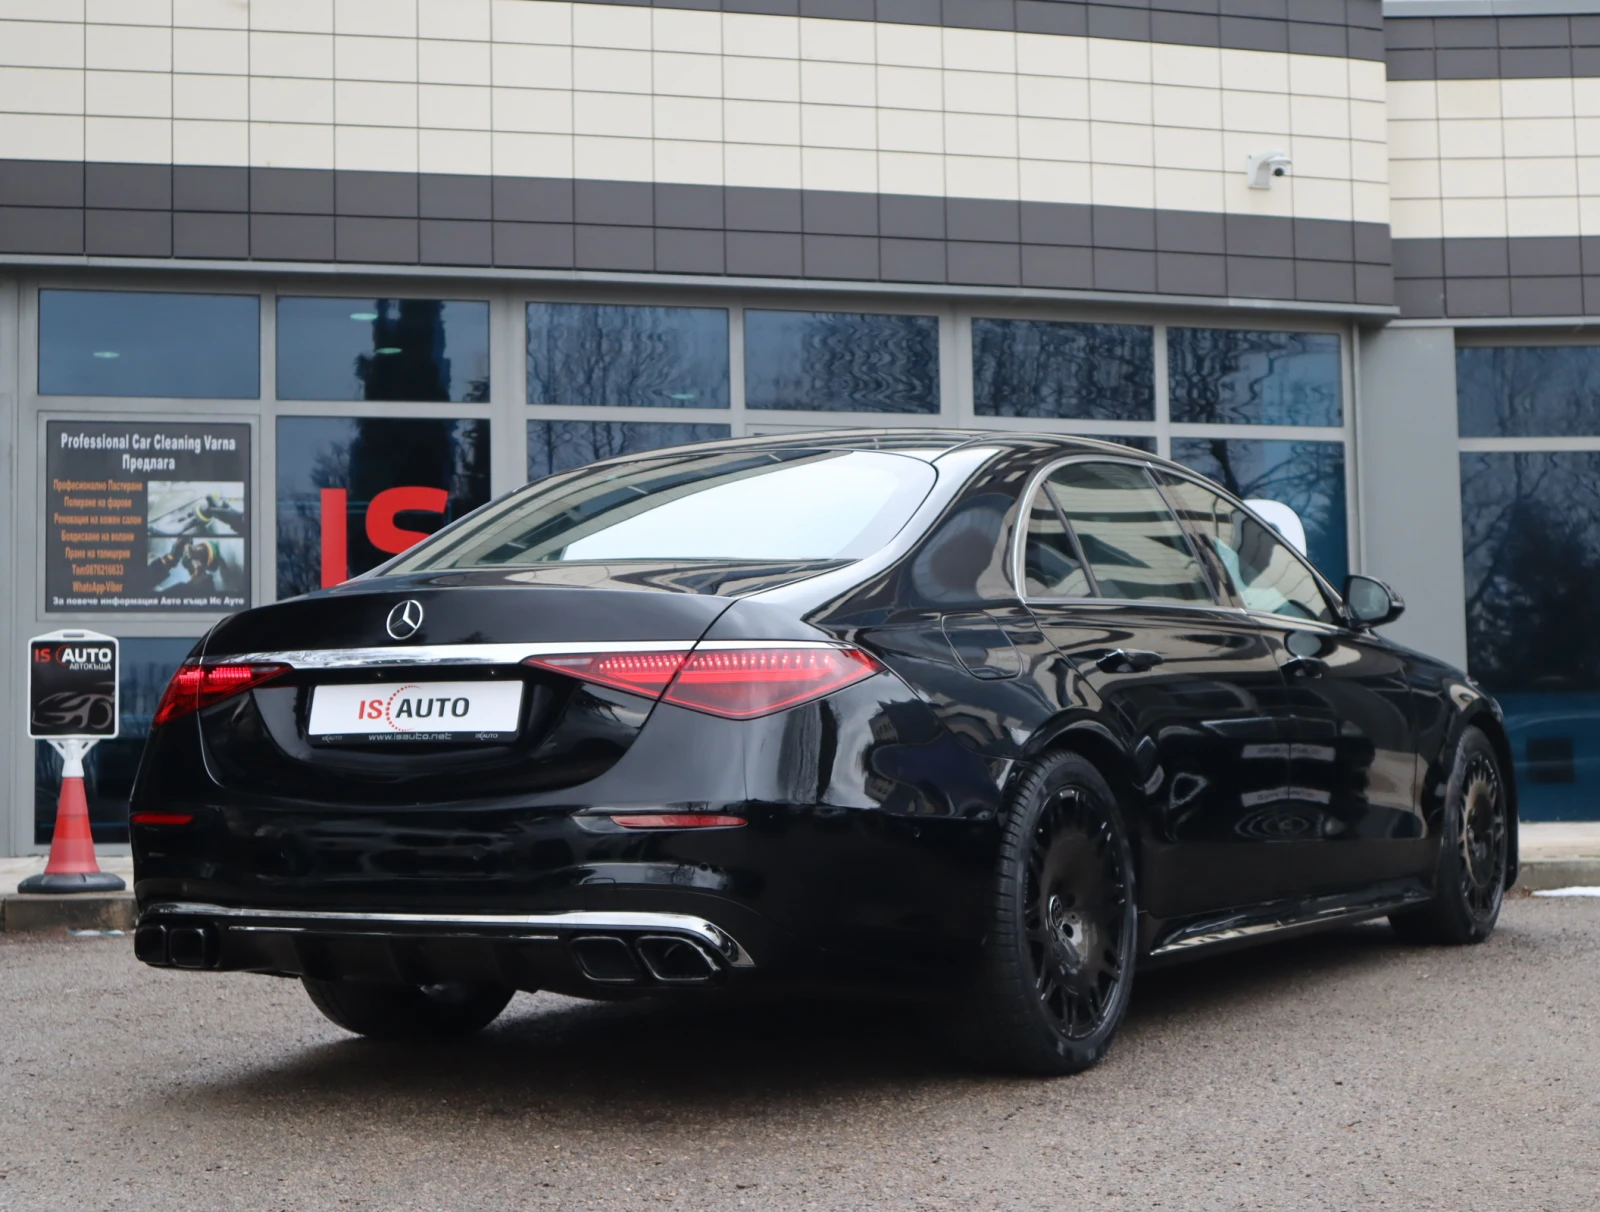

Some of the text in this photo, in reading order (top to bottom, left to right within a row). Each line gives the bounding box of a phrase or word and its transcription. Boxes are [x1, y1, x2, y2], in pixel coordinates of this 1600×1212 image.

[61, 433, 236, 453] Professional Car Cleaning Varna
[122, 454, 175, 472] Предлага
[53, 479, 107, 492] Професионално
[64, 496, 132, 510] Полиране на фарове
[90, 516, 99, 525] на
[101, 533, 110, 542] на
[65, 547, 86, 560] Пране
[87, 550, 96, 559] на
[53, 597, 64, 606] За
[66, 598, 98, 606] повече
[100, 597, 158, 607] информация
[161, 597, 181, 606] Авто
[183, 598, 208, 607] къща
[223, 598, 245, 607] Ауто
[35, 648, 112, 663] IS AUTO
[69, 663, 111, 671] АВТОКЪЩА
[358, 697, 470, 719] IS AUTO
[368, 732, 452, 741] www.isauto.net
